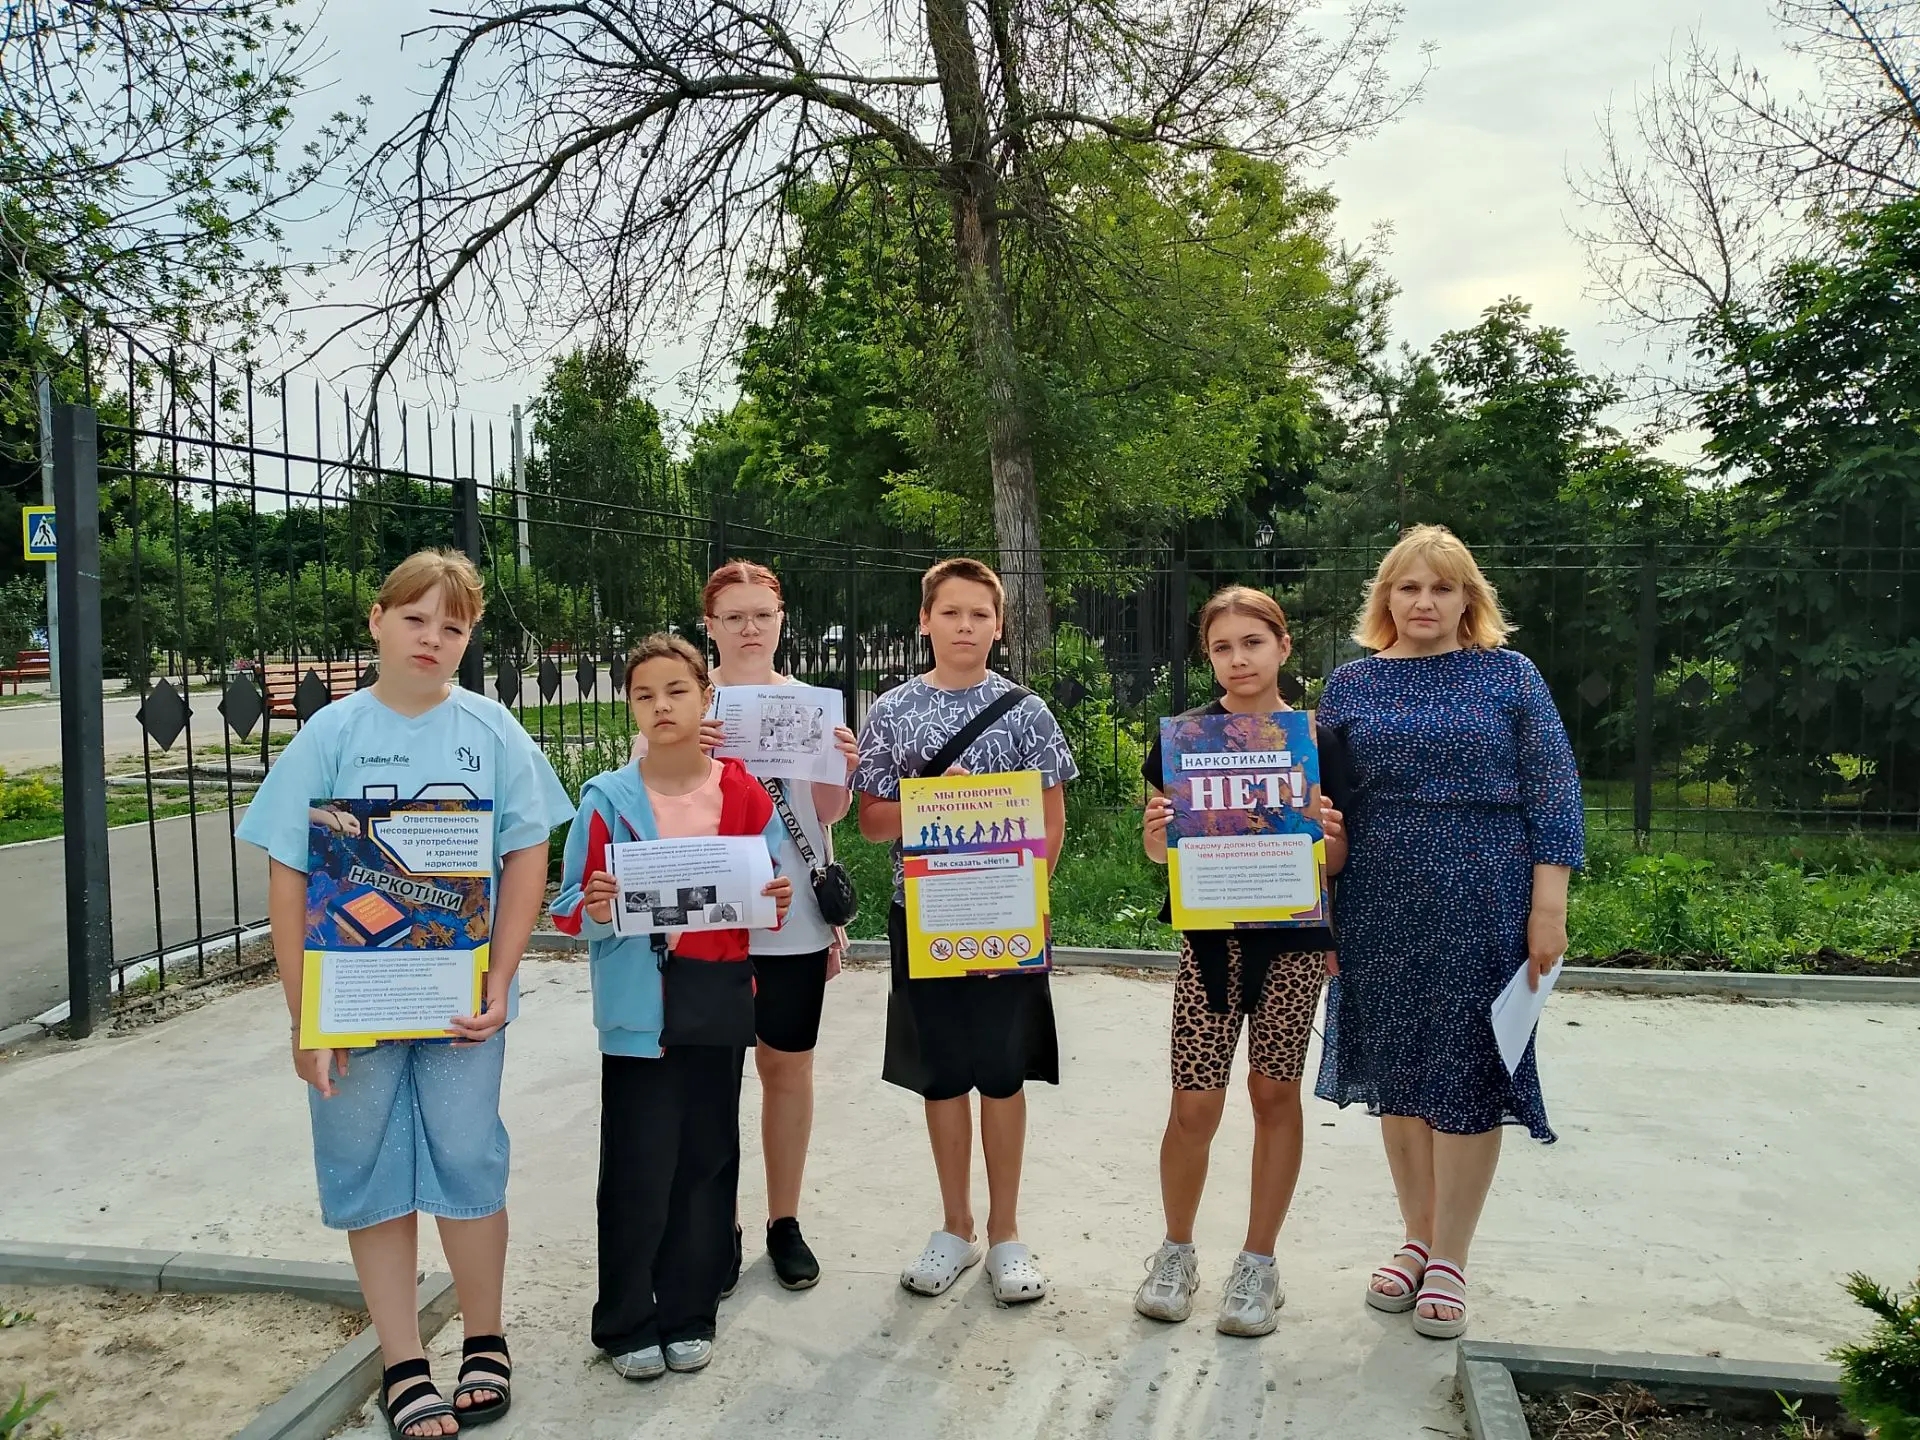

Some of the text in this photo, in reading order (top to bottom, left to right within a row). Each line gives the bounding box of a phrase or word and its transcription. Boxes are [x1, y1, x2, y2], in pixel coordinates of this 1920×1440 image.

[1185, 754, 1278, 767] НАРКОТИКАМ
[934, 788, 1012, 800] МЫ ГОВОРИМ
[1188, 772, 1304, 811] НЕТ!
[917, 802, 993, 813] НАРКОТИКАМ
[402, 816, 479, 824] Ответственность
[380, 827, 478, 836] несовершеннолетних
[416, 837, 478, 848] употребление
[1184, 842, 1222, 853] Каждому
[1224, 842, 1256, 850] должно
[1258, 840, 1280, 848] быть
[434, 850, 478, 858] хранение
[1216, 852, 1258, 860] наркотики
[1261, 850, 1294, 858] опасны
[424, 861, 478, 869] наркотиков
[934, 860, 948, 868] Как
[951, 859, 982, 868] сказать
[351, 867, 461, 910] НАРКОТИКИ
